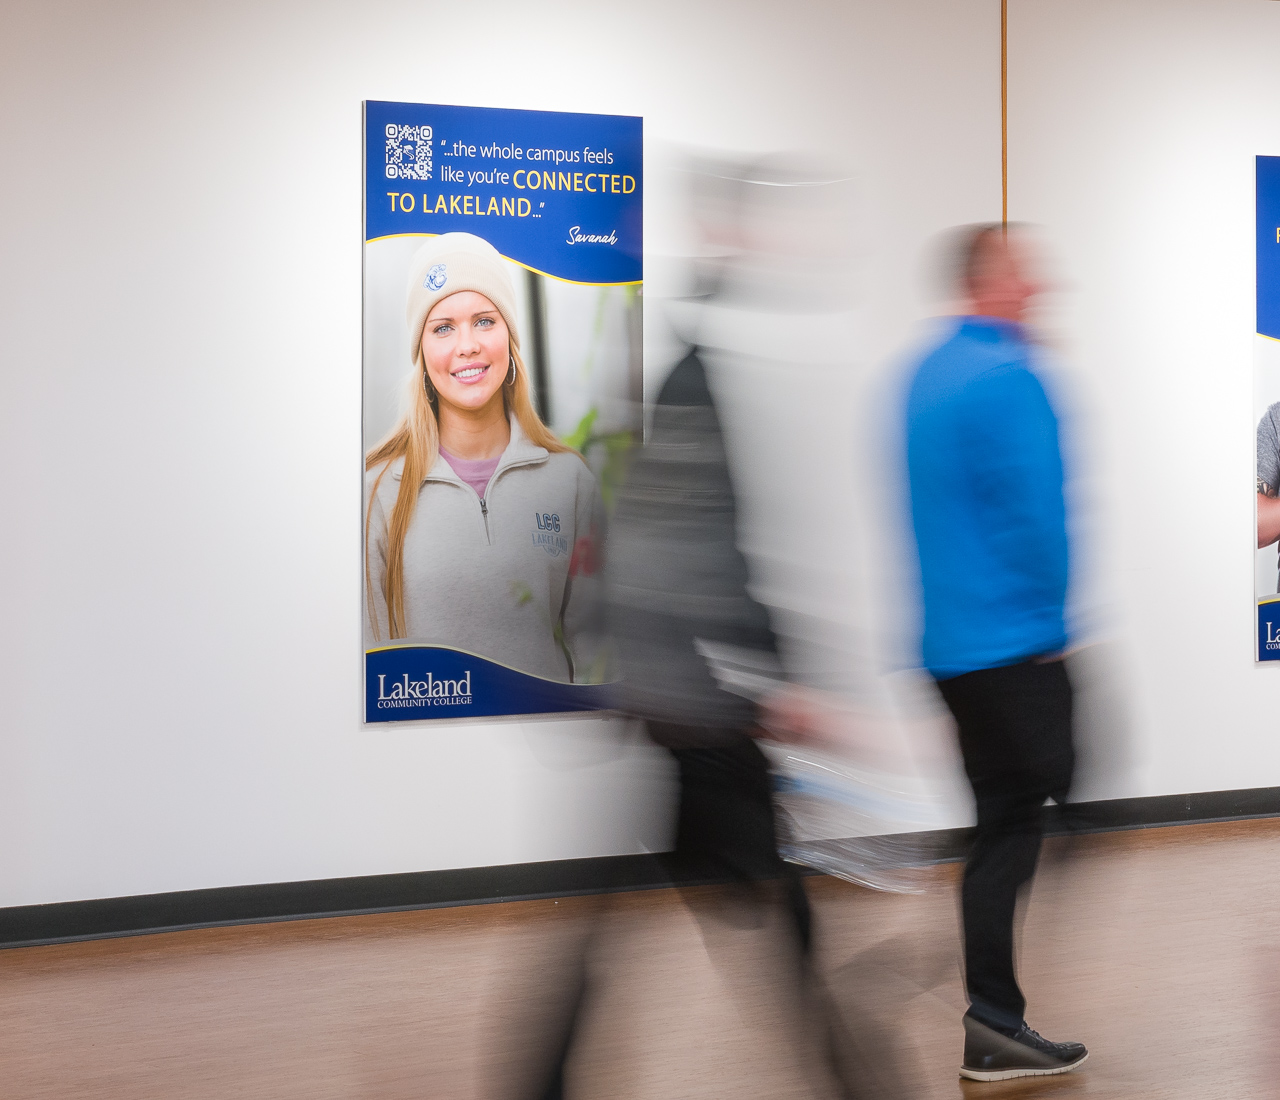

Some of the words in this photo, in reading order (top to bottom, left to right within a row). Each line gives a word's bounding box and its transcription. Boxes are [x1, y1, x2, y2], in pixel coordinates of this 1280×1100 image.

[480, 143, 522, 159] whole
[526, 149, 579, 164] campus
[583, 147, 614, 164] feels
[441, 166, 464, 182] like
[513, 170, 636, 194] CONNECTED
[387, 192, 415, 212] TO
[566, 226, 618, 245] Savanah
[536, 512, 560, 532] LCC
[378, 671, 472, 700] Lakeland
[378, 699, 431, 708] COMMUNITY
[434, 697, 472, 705] COLLEGE
